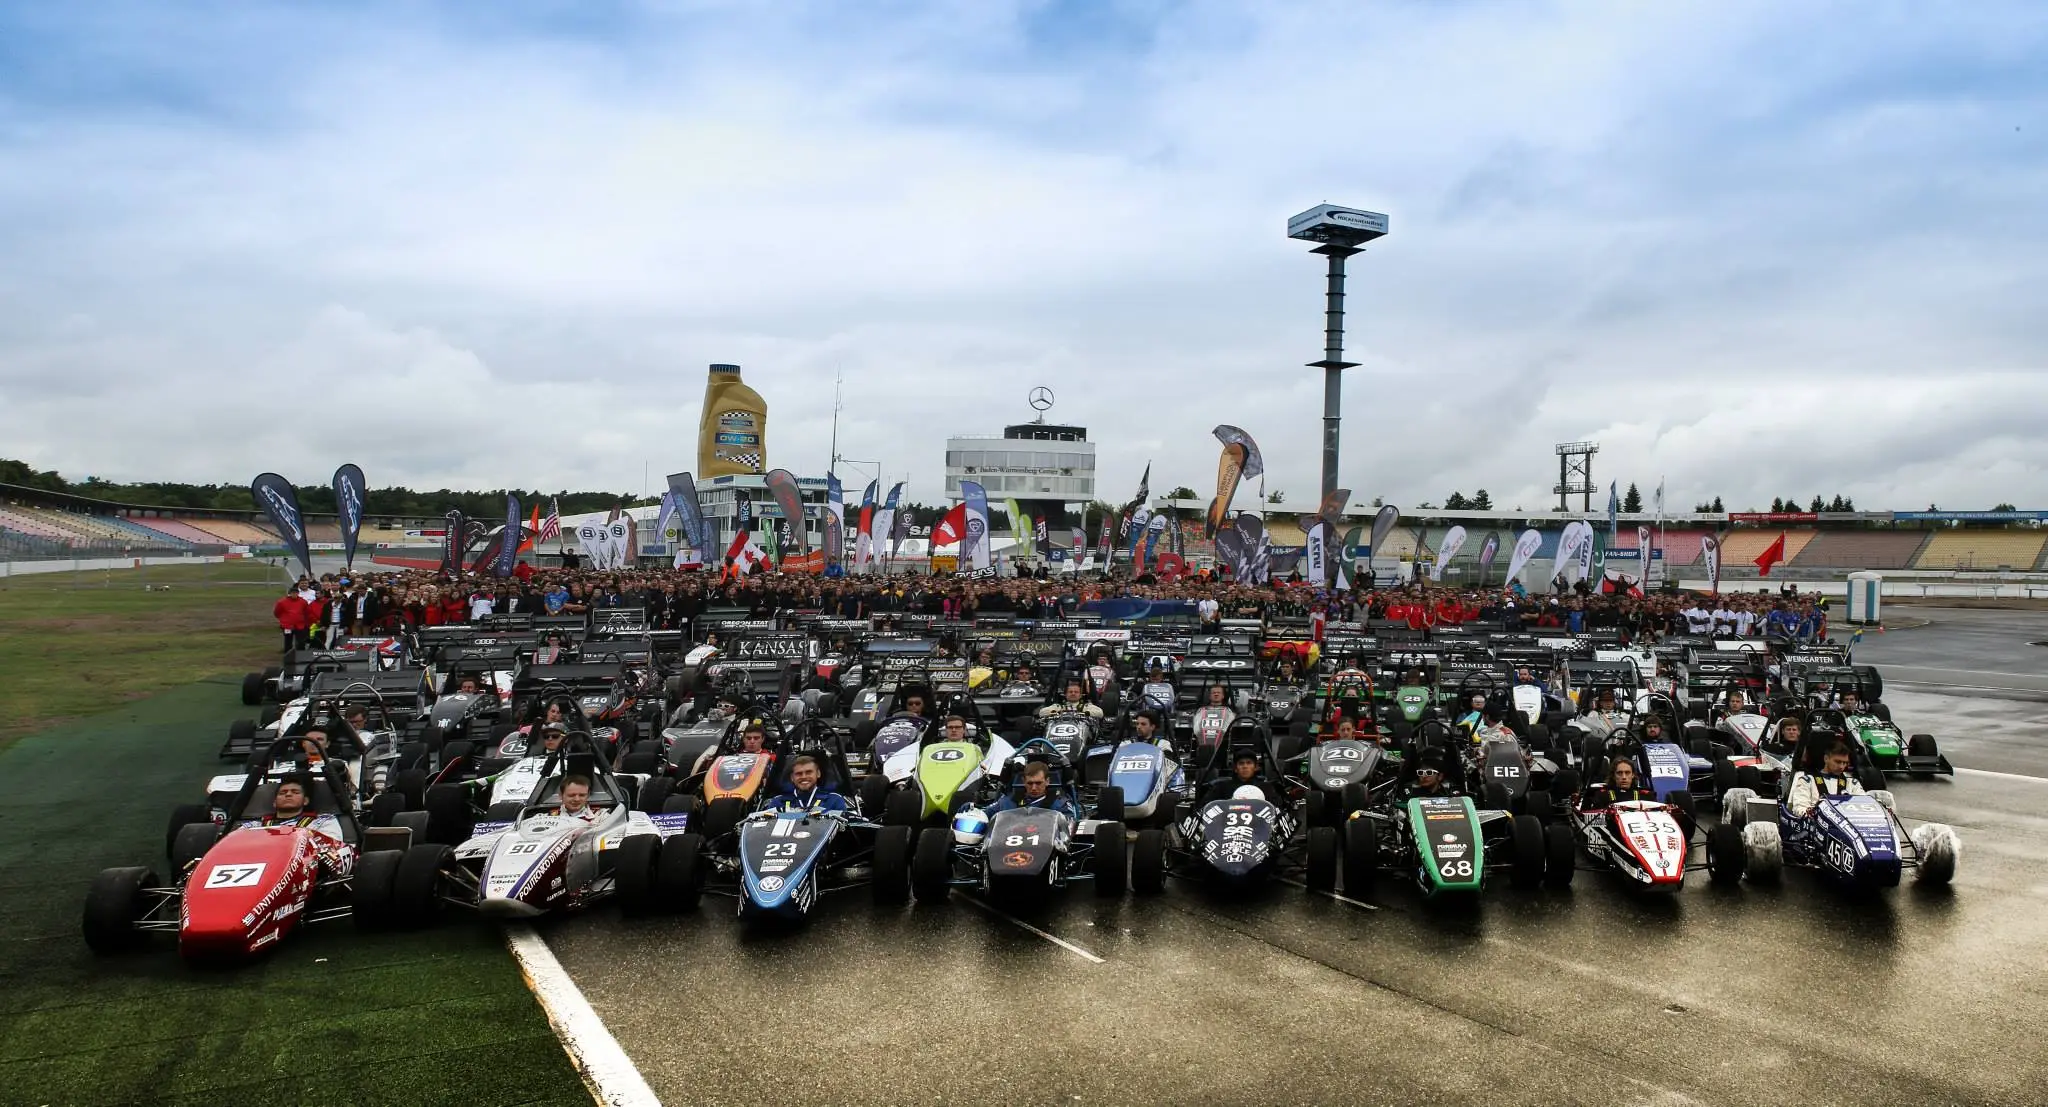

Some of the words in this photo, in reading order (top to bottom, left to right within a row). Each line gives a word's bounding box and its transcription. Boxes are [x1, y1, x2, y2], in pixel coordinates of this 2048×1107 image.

[739, 641, 804, 655] KANSAS
[1010, 642, 1052, 651] AKRON
[1192, 660, 1246, 668] AGP
[1786, 655, 1833, 663] WEINGARTEN
[930, 671, 965, 679] AIRTECH
[936, 751, 958, 760] 14
[1494, 766, 1520, 777] E12
[1227, 813, 1253, 825] 39
[1627, 822, 1676, 834] E35
[1005, 835, 1039, 846] 81
[509, 843, 538, 854] 90
[764, 843, 798, 857] 23
[1828, 840, 1841, 866] 45
[1048, 855, 1059, 885] 81
[1440, 860, 1473, 877] 68
[212, 868, 259, 885] 57
[519, 859, 551, 901] POLITECNICO
[252, 870, 293, 916] UNIVERSITY
